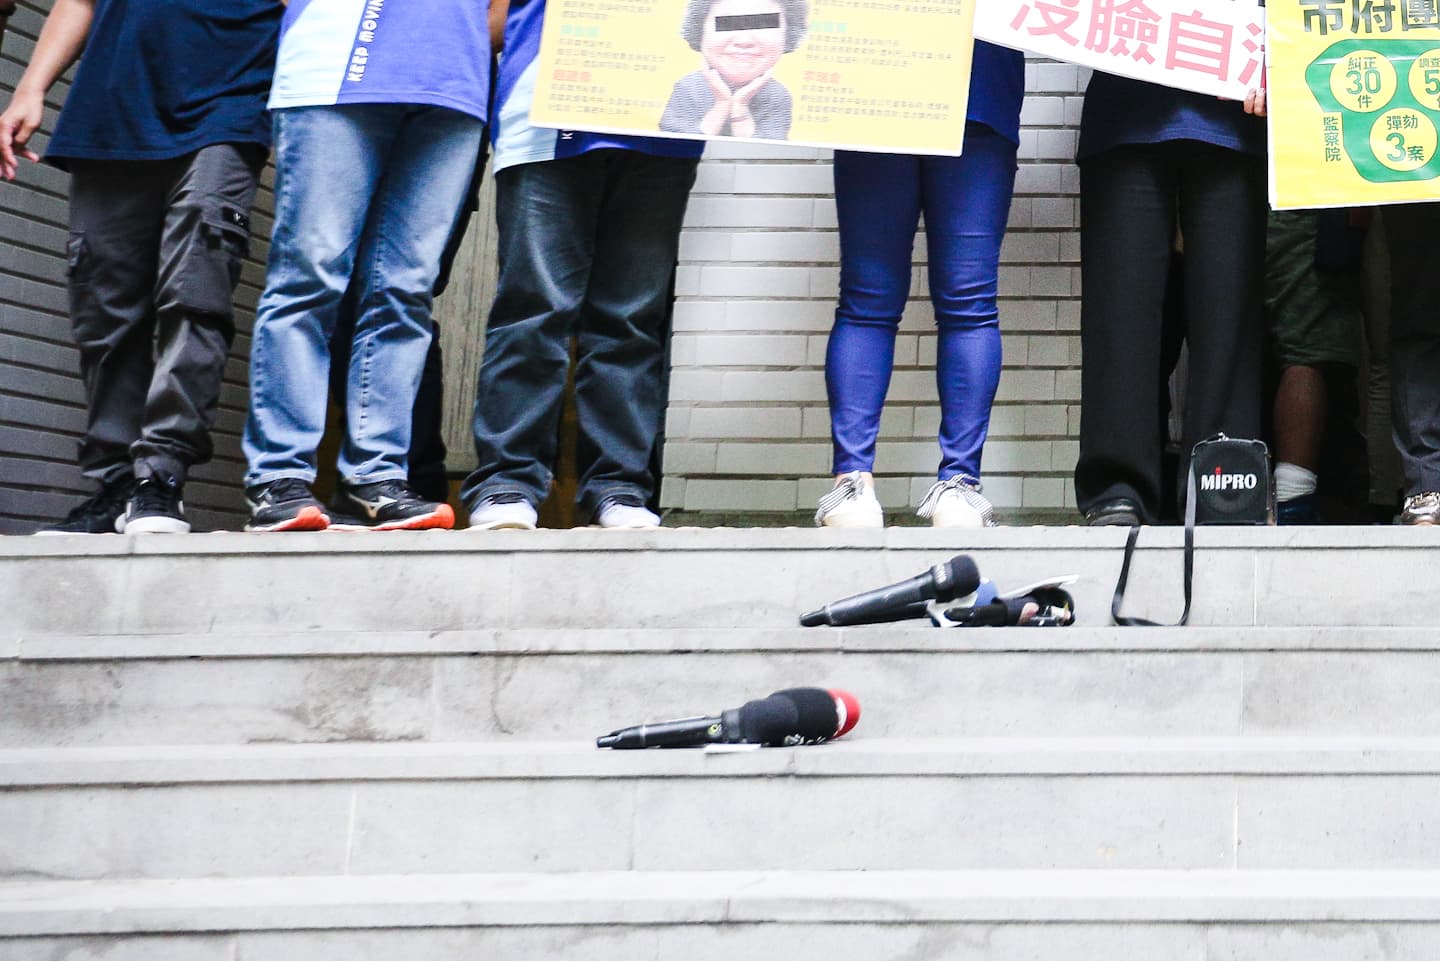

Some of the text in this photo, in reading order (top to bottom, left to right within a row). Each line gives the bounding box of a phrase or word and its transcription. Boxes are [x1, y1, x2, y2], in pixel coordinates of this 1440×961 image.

[347, 46, 369, 82] KEEP
[1345, 69, 1382, 95] 30
[1357, 94, 1373, 108] 件
[1323, 116, 1341, 162] 監察院
